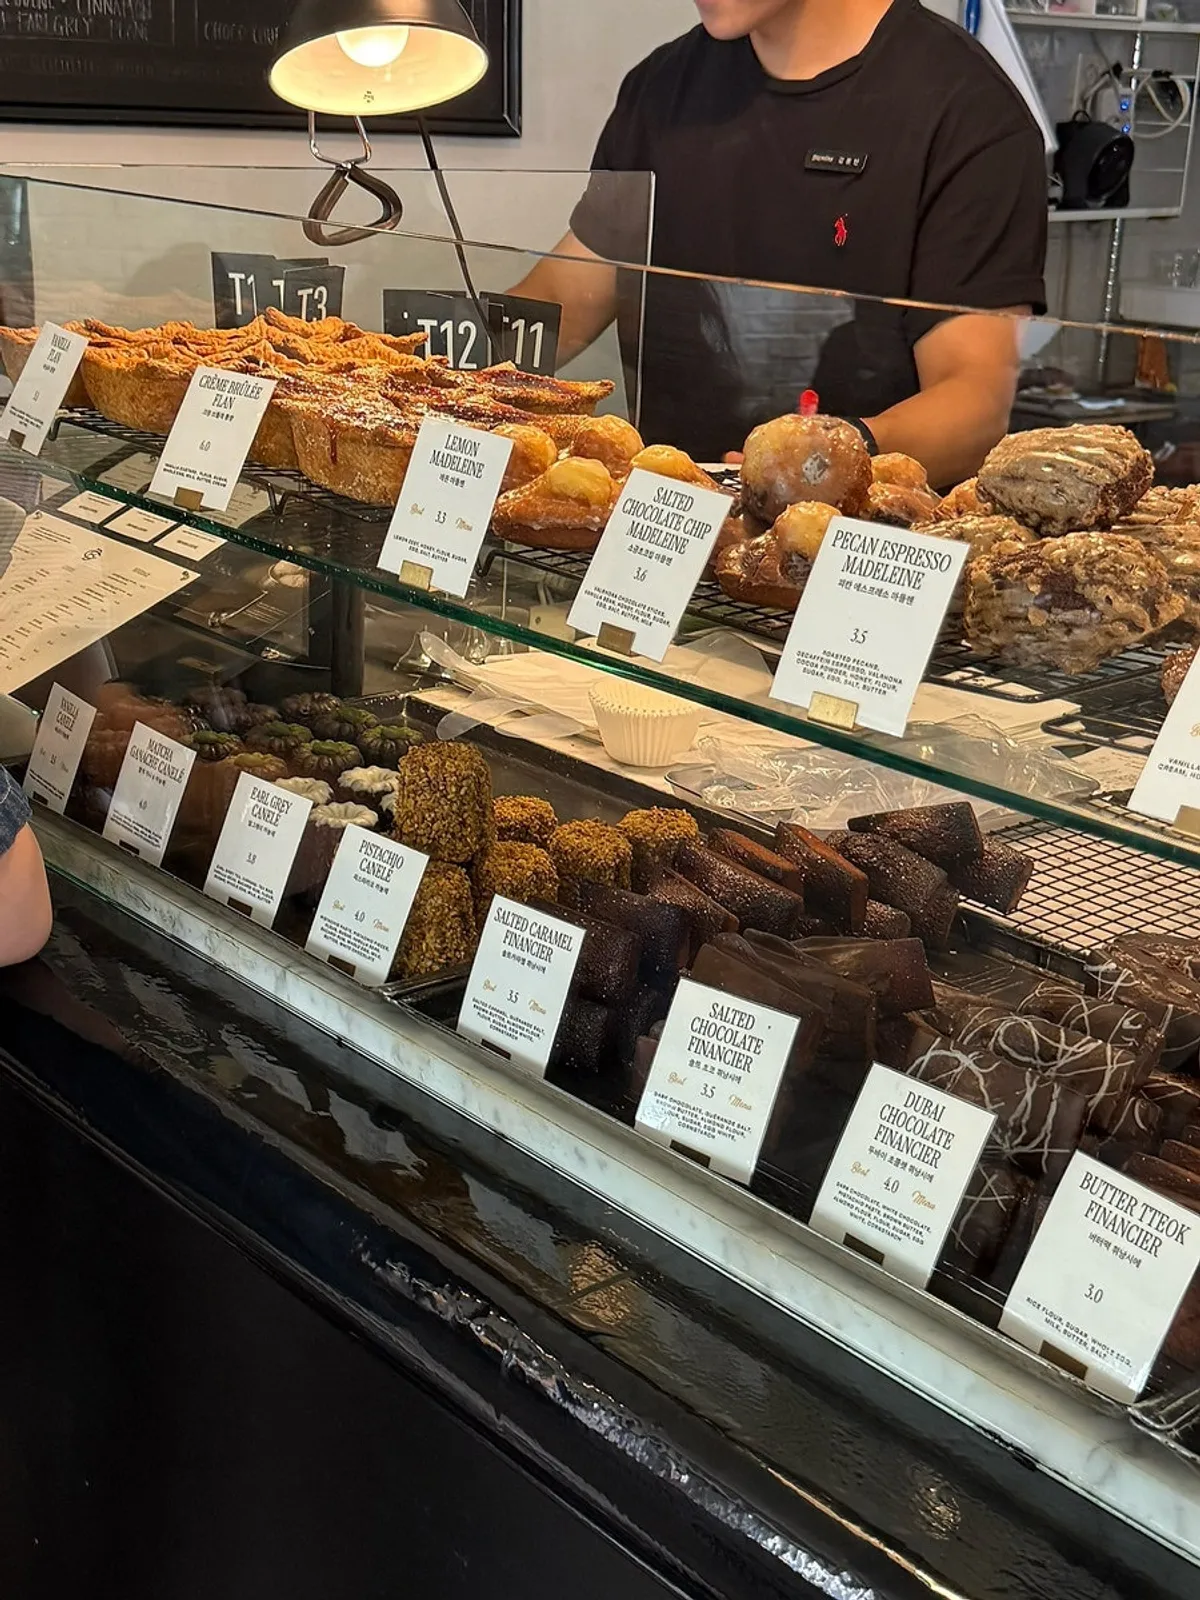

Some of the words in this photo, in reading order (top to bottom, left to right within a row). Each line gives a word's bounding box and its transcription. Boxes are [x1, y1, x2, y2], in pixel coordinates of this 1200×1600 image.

[297, 285, 328, 322] T3
[417, 318, 477, 370] T12
[212, 393, 236, 410] FLAN
[444, 434, 481, 457] LEMON
[429, 449, 485, 479] MADELEINE
[653, 487, 694, 512] SALTED
[435, 510, 447, 524] 3.3
[622, 498, 685, 532] CHOCOLATE
[683, 518, 712, 540] CHIP
[625, 520, 690, 555] MADELEINE
[831, 529, 880, 556] PECAN
[878, 540, 952, 573] ESPRESSO
[633, 567, 648, 582] 3.6
[841, 554, 926, 590] MADELEINE
[850, 628, 868, 644] 3.5
[796, 658, 819, 669] COCOA
[822, 650, 852, 663] ROASTED
[862, 684, 887, 695] BUTTER
[129, 745, 159, 770] GANACHE
[147, 738, 174, 763] MATCHA
[250, 786, 270, 806] EARL
[270, 795, 293, 815] GREY
[354, 910, 365, 923] 4.0
[493, 907, 529, 932] SALTED
[529, 921, 573, 952] CARAMEL
[502, 929, 554, 963] FINANCIER
[507, 989, 519, 1004] 3.5
[709, 1002, 756, 1031] SALTED
[690, 1016, 764, 1056] CHOCOLATE
[687, 1035, 753, 1074] FINANCIER
[667, 1072, 687, 1086] Best
[700, 1083, 716, 1099] 3.5
[728, 1094, 752, 1111] Menu
[903, 1091, 946, 1123] DUBAI
[879, 1104, 955, 1151] CHOCOLATE
[868, 1145, 888, 1161] 두바이
[874, 1124, 942, 1169] FINANCIER
[850, 1161, 871, 1177] Best
[883, 1177, 900, 1194] 4.0
[912, 1190, 936, 1210] Menu
[1079, 1171, 1138, 1217] BUTTER
[1138, 1202, 1192, 1246] TTEOK
[1084, 1200, 1163, 1258] FINANCIER
[1084, 1283, 1104, 1304] 3.0
